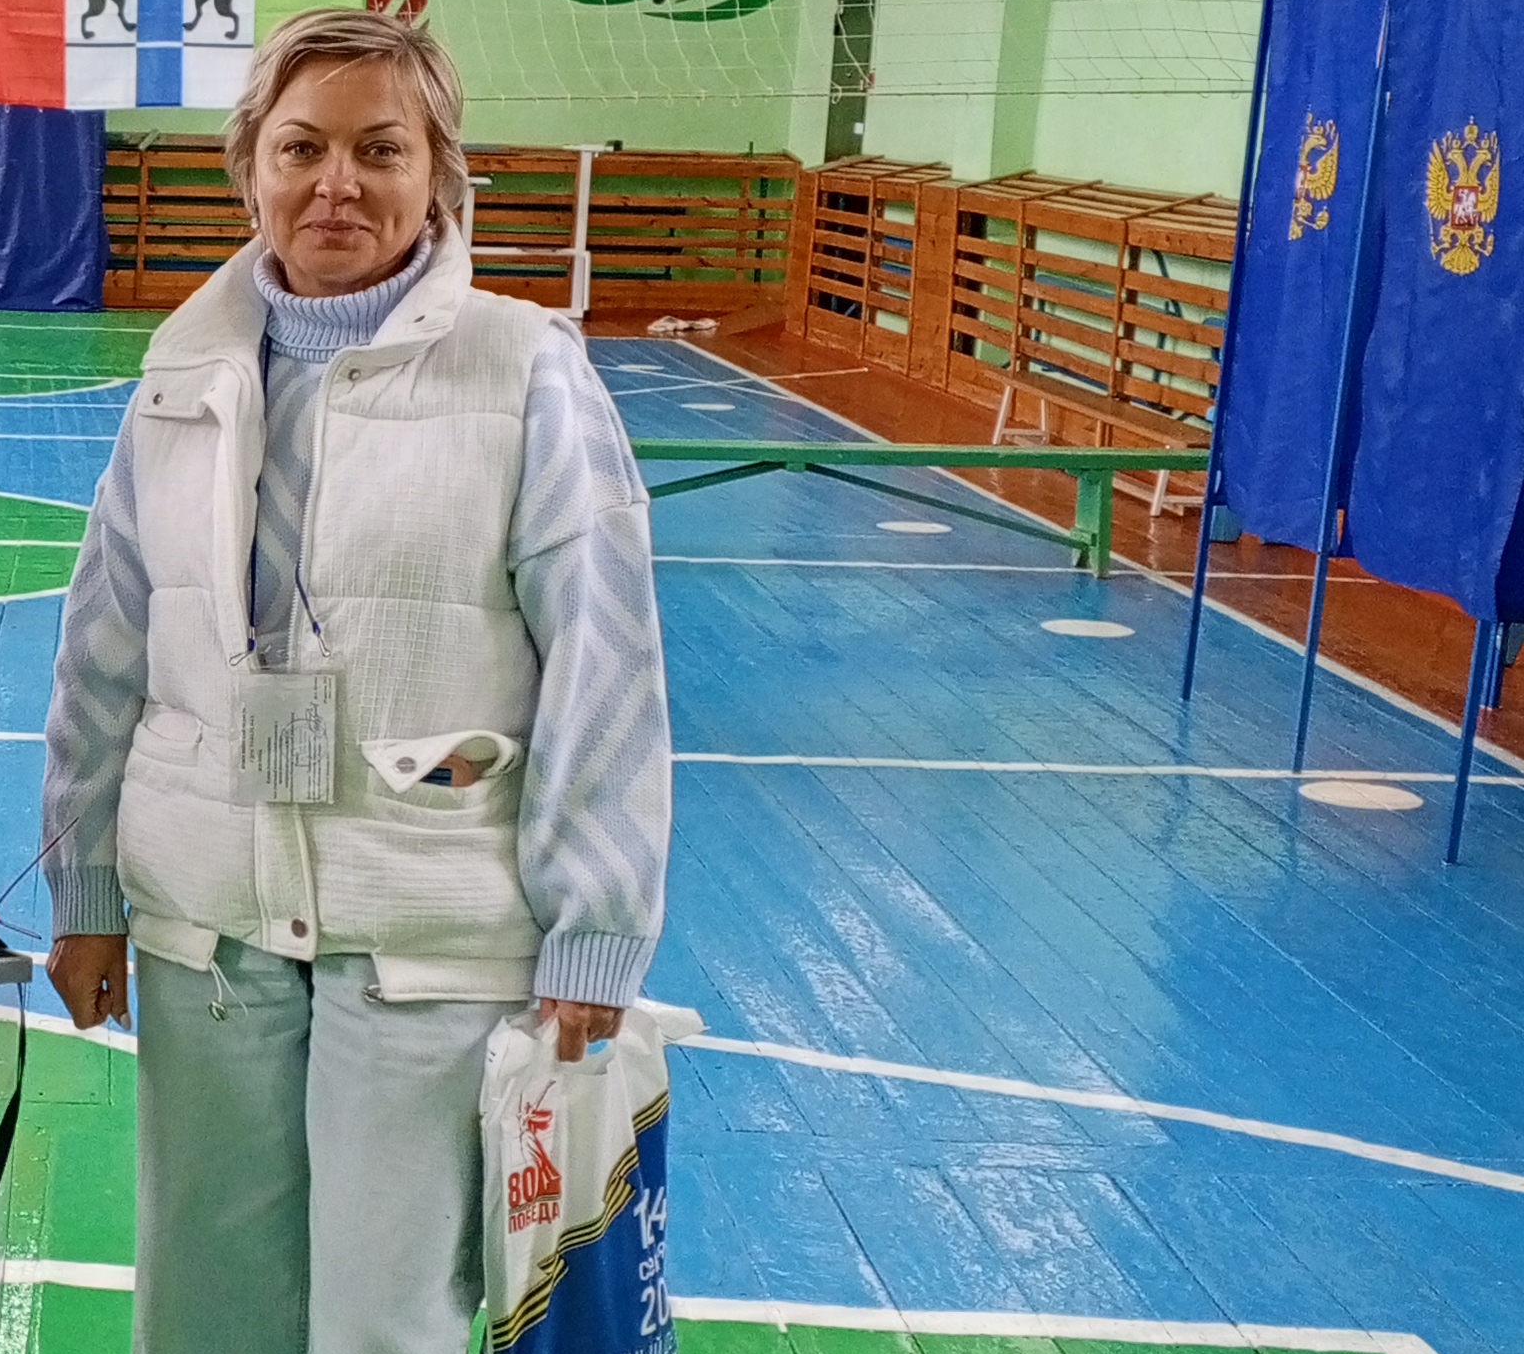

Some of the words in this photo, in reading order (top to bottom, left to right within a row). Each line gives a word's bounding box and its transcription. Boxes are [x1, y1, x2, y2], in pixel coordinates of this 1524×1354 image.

[508, 1166, 536, 1209] 80
[509, 1202, 560, 1234] ПОБЕДА
[634, 1186, 667, 1249] 14
